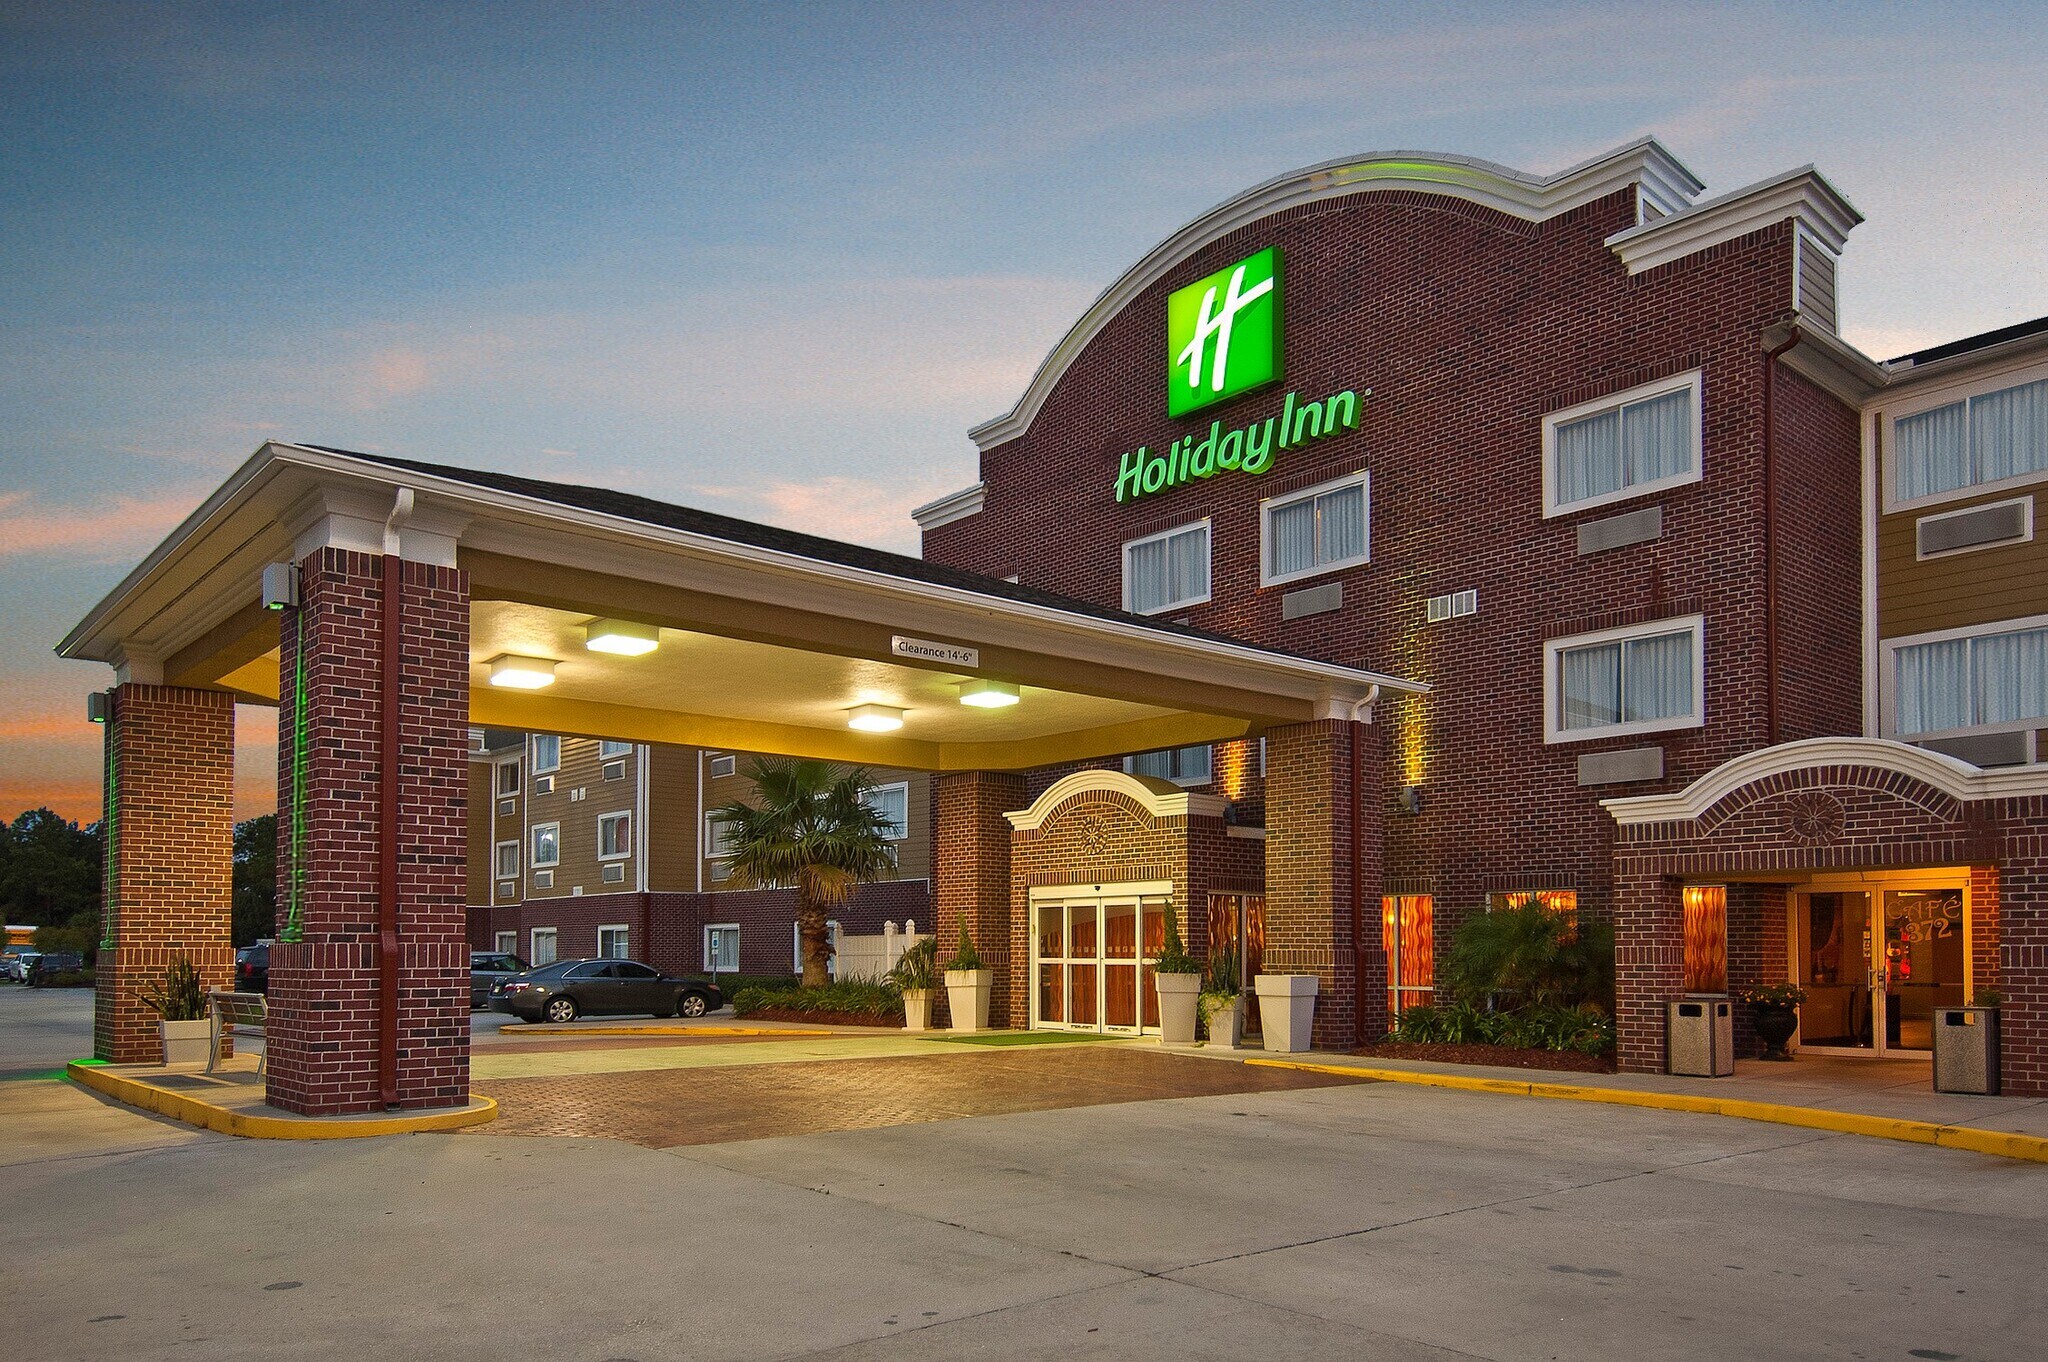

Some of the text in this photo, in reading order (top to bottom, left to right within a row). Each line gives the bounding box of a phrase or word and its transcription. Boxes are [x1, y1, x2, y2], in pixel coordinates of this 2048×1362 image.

[1177, 264, 1273, 392] H
[1113, 390, 1358, 503] Holiday Inn
[898, 641, 945, 658] Clearance
[1887, 895, 1962, 921] CAFÉ
[1905, 917, 1952, 943] 372
